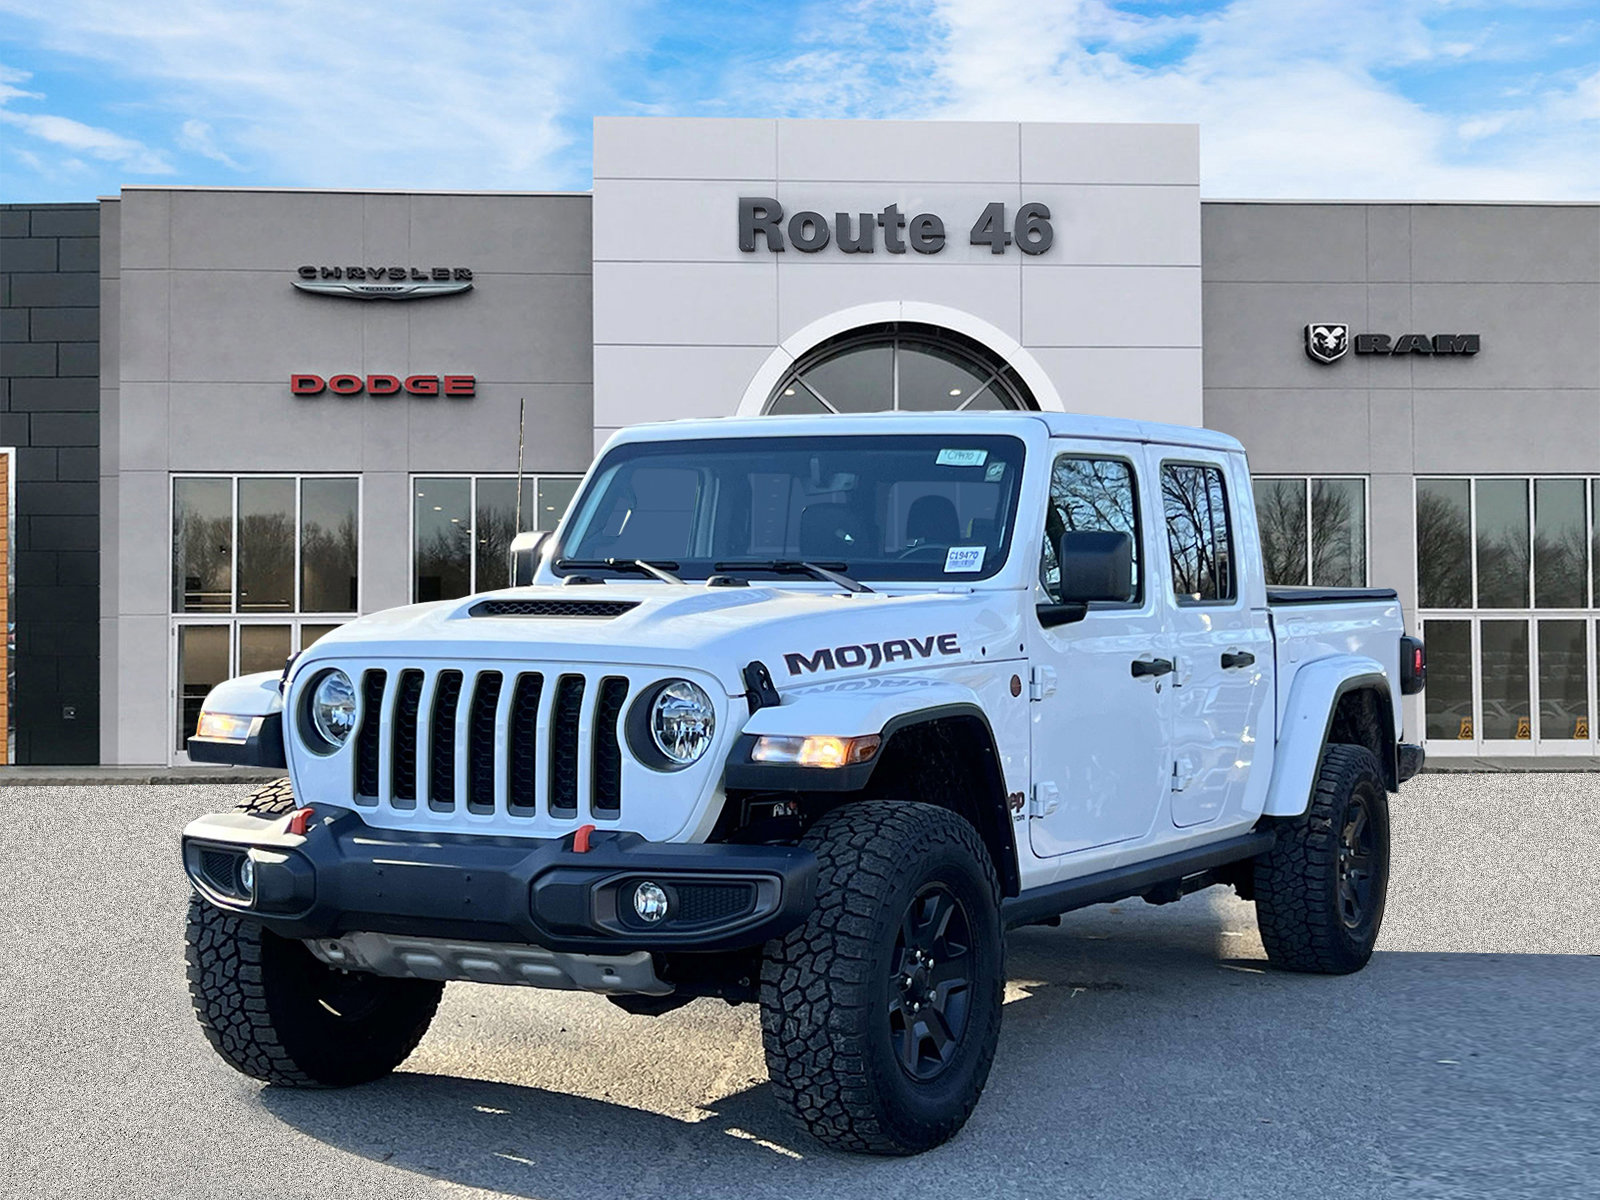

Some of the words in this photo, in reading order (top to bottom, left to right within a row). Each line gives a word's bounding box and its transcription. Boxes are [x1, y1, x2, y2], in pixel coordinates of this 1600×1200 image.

[738, 196, 945, 254] Route
[969, 202, 1054, 256] 46
[298, 266, 473, 281] CHRYSLER
[1355, 333, 1480, 356] RAM
[291, 373, 476, 397] DODGE
[949, 551, 979, 560] C19470
[784, 633, 961, 676] MOJAVE
[1008, 792, 1025, 813] ep
